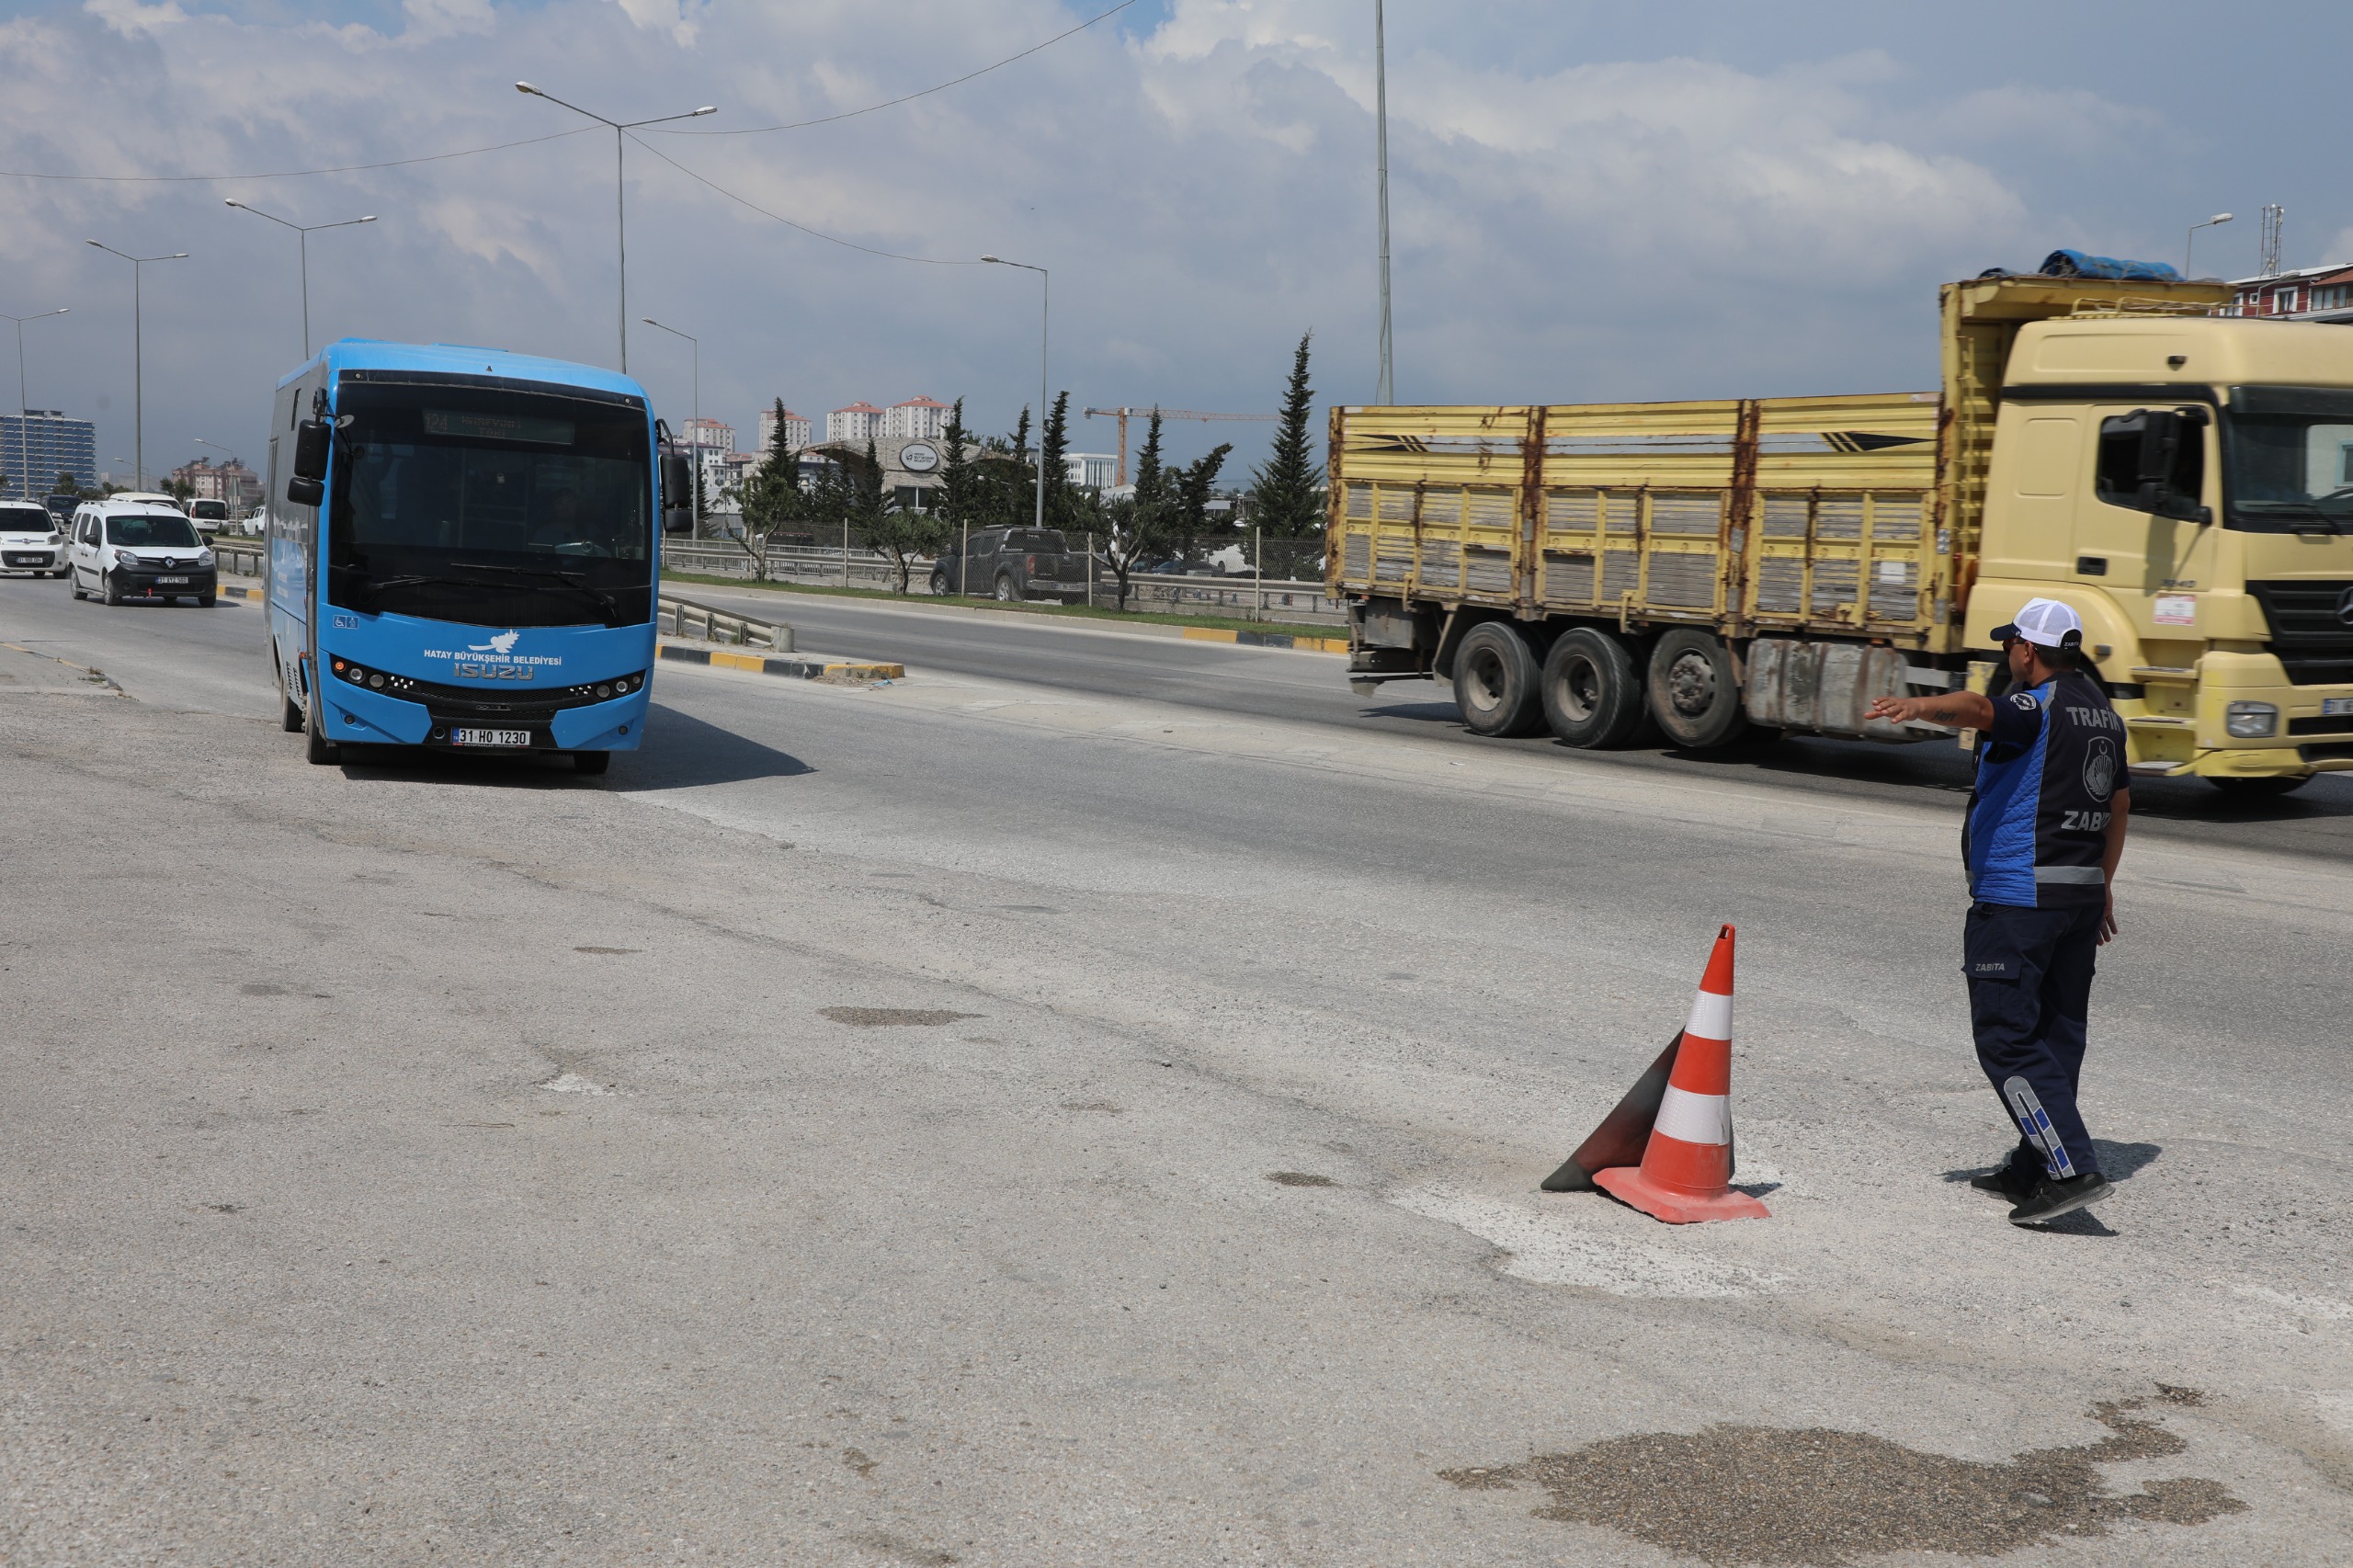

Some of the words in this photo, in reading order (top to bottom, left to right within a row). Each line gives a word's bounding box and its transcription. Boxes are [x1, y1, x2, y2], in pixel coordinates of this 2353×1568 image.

[424, 650, 452, 659] HATAY
[454, 652, 510, 664] BÜYÜKŞEHİR
[513, 655, 563, 665] BELEDİYESİ
[454, 663, 533, 680] ISUZU
[460, 729, 473, 743] 31
[499, 731, 527, 744] 1230
[1975, 963, 2006, 971] ZABITA
